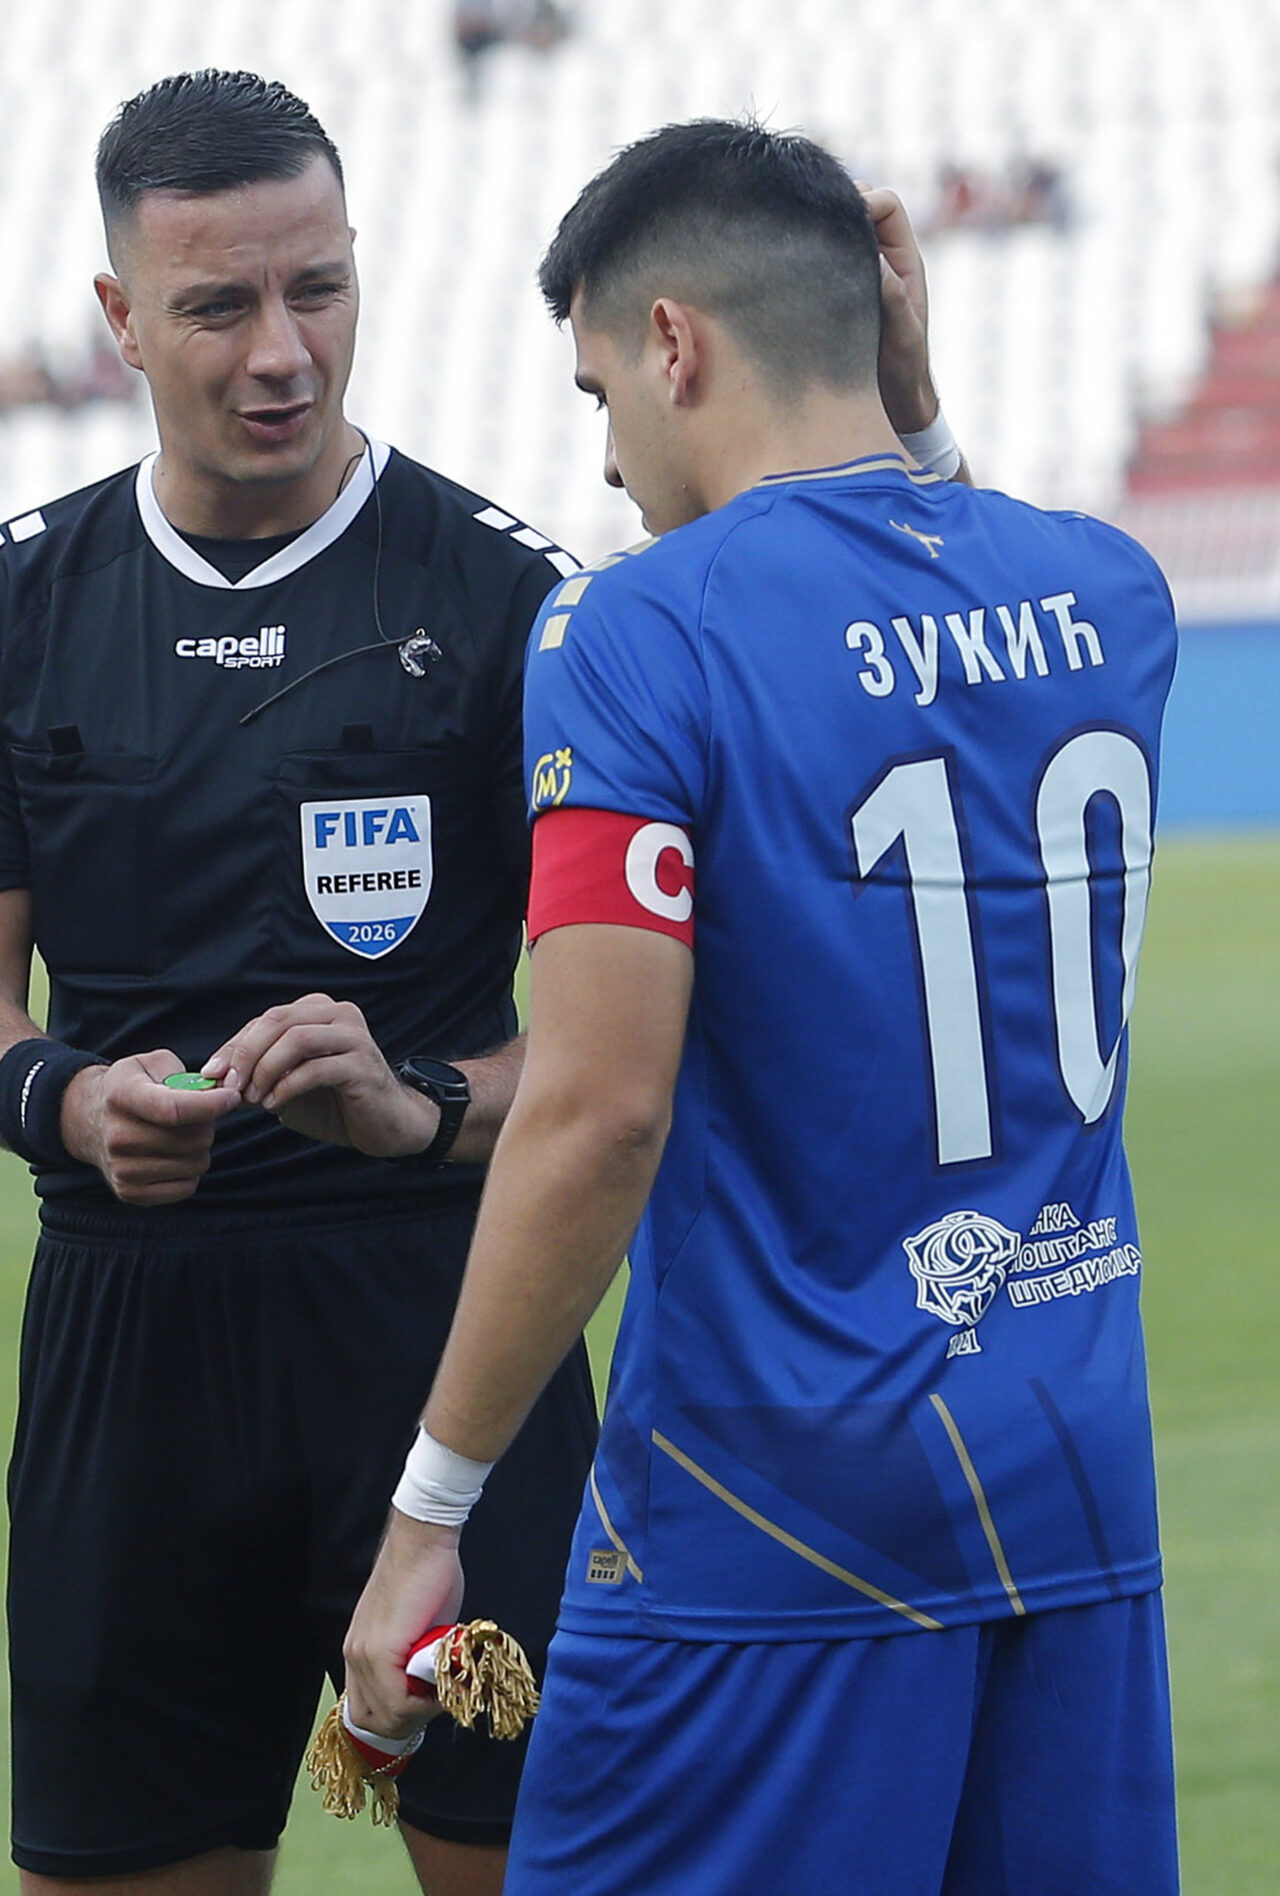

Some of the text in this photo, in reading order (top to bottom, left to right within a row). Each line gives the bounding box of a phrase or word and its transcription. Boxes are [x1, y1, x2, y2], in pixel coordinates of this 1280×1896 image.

[175, 625, 285, 664] capelli
[223, 654, 285, 669] SPORT
[845, 591, 1105, 706] ЗУКИЋ
[314, 808, 420, 849] FIFA
[317, 869, 422, 895] REFEREE
[625, 822, 696, 922] C
[348, 923, 397, 944] 2026
[851, 730, 1152, 1166] 10
